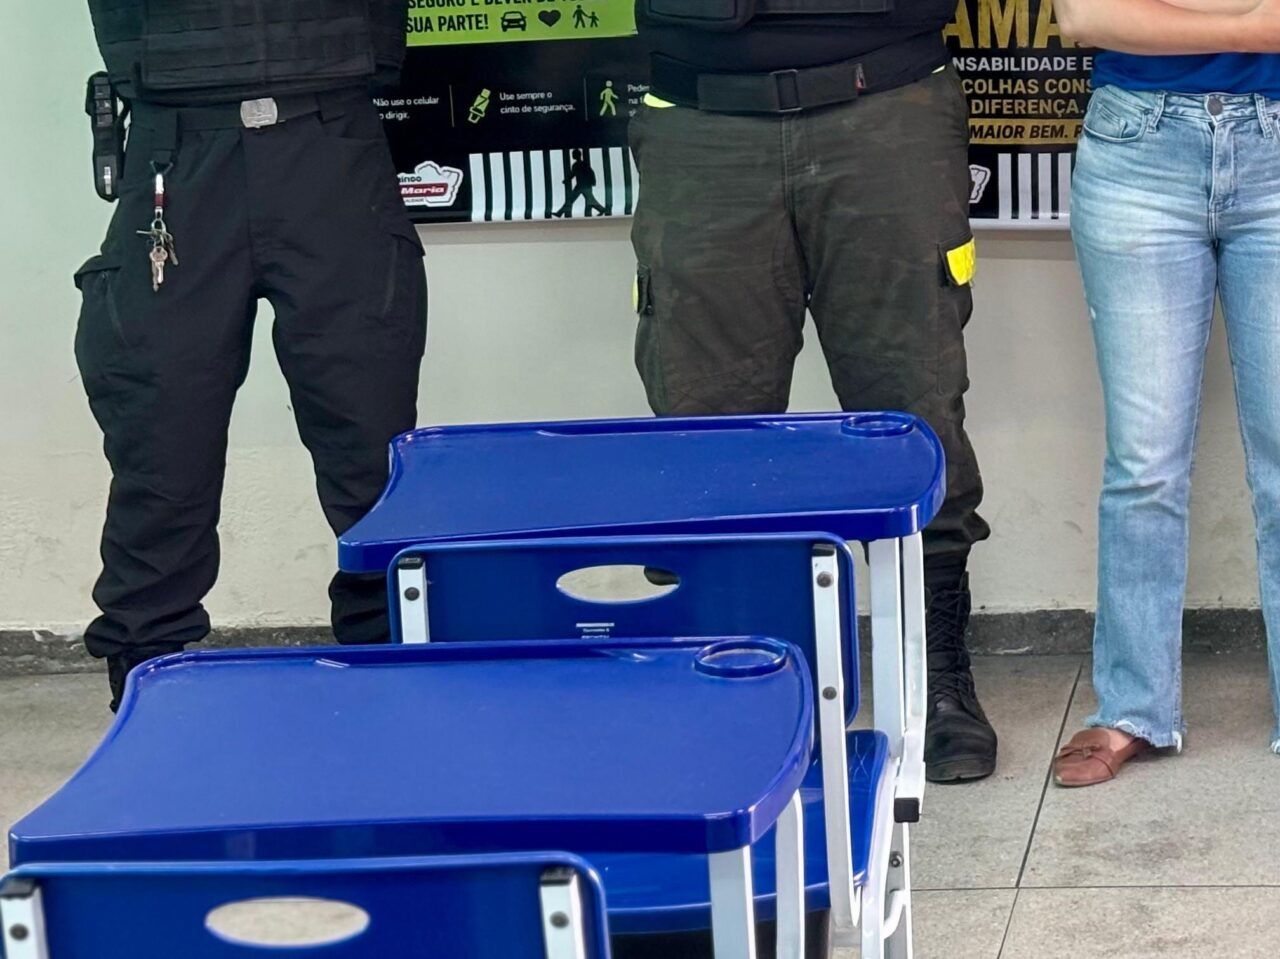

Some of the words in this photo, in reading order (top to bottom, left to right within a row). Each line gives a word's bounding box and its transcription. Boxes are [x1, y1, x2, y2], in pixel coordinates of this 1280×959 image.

[406, 15, 434, 33] SUA
[438, 13, 489, 32] PARTE!
[952, 57, 1076, 72] NSABILIDADE
[962, 78, 1039, 95] COLHAS
[413, 96, 439, 105] celular
[500, 92, 514, 101] Use
[516, 92, 545, 101] sempre
[500, 106, 520, 114] cinto
[521, 105, 532, 113] de
[971, 98, 1084, 118] DIFERENÇA.
[970, 125, 1025, 139] MAIOR
[1030, 125, 1068, 138] BEM.
